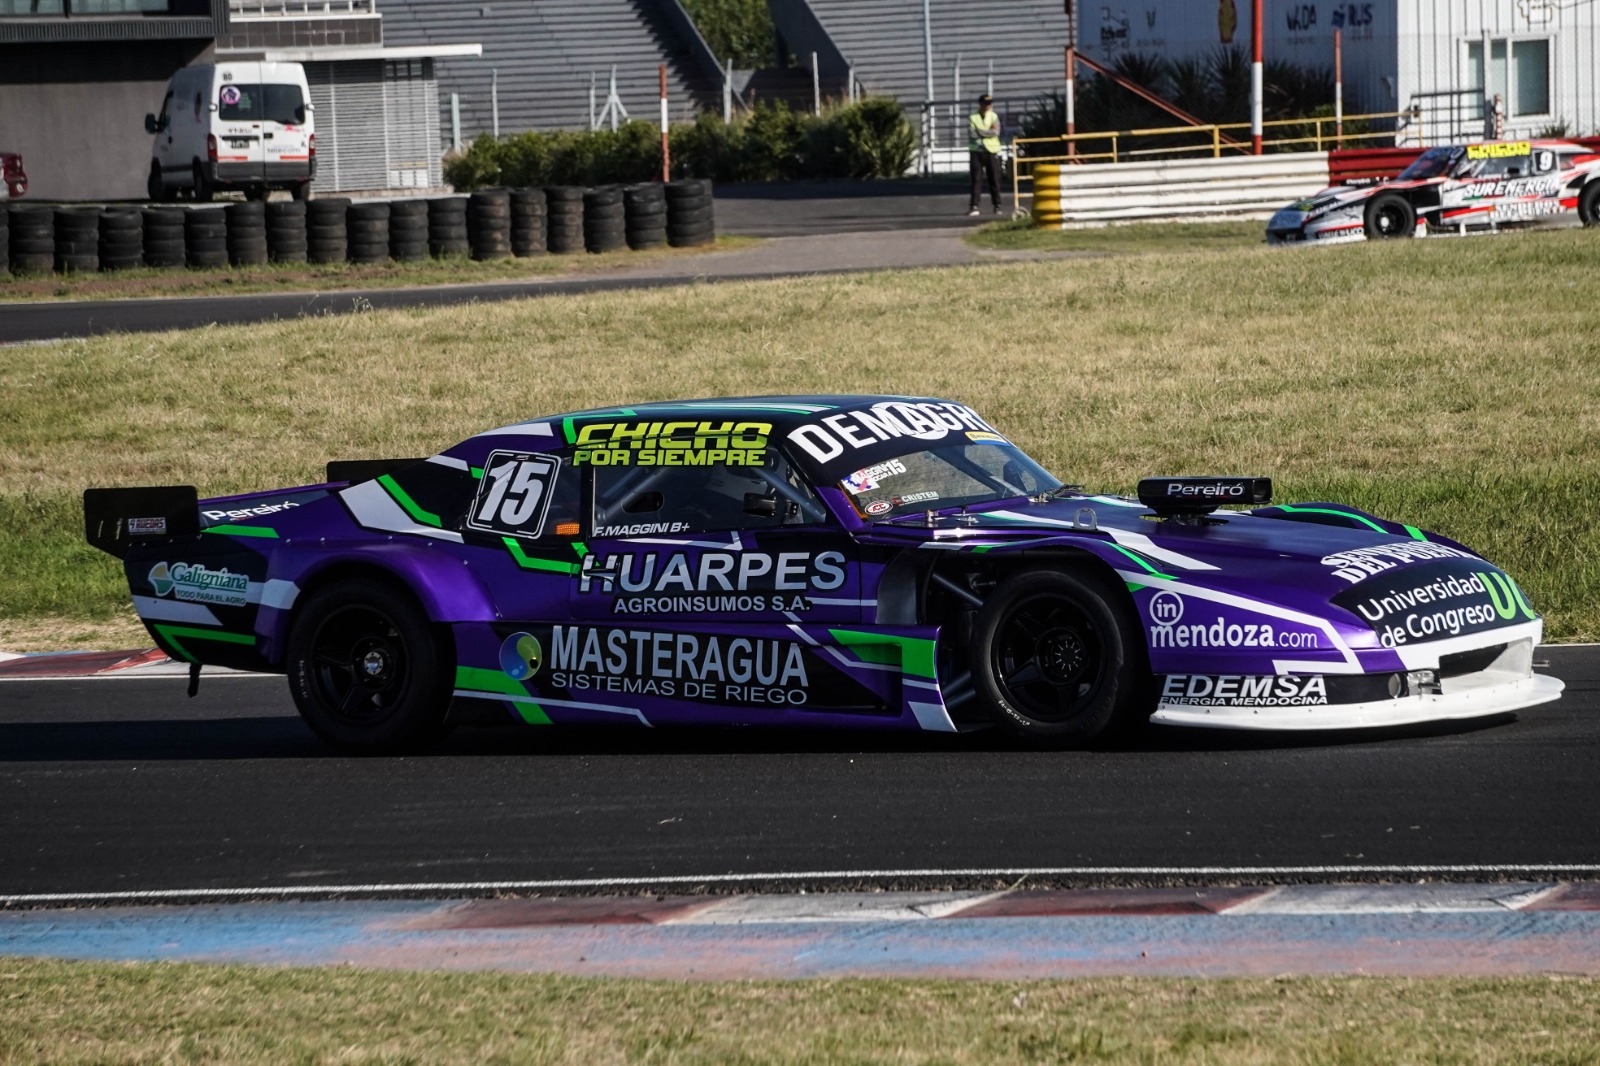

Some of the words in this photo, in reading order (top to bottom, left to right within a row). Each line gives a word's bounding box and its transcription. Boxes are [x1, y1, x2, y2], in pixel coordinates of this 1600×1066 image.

[1539, 151, 1553, 171] 9
[576, 421, 773, 449] CHICHO
[787, 401, 1000, 464] DEMAGR
[573, 449, 631, 467] POR
[636, 449, 767, 467] SIEMPRE
[477, 460, 551, 526] 15
[901, 491, 940, 503] CRISTEM
[1166, 482, 1246, 496] Pereiró
[593, 523, 669, 538] F.MAGGINI
[670, 521, 691, 533] B+
[171, 564, 249, 590] Galigniana
[579, 551, 846, 592] HUARPES
[177, 590, 196, 598] TODO
[225, 596, 246, 605] AGRO
[613, 596, 766, 613] AGROINSUMOS
[771, 595, 811, 612] S.A.
[1156, 599, 1178, 618] in
[1357, 572, 1486, 621] Universidad
[1150, 617, 1319, 649] mendoza.com
[1380, 625, 1407, 648] de
[1406, 603, 1496, 638] Congreso
[550, 625, 809, 687] MASTERAGUA
[551, 672, 677, 697] SISTEMAS
[683, 680, 719, 699] DE
[725, 685, 808, 705] RIEGO
[1161, 675, 1328, 698] EDEMSA
[1160, 696, 1227, 706] ENERGIA
[1230, 696, 1329, 706] MENDOCINA
